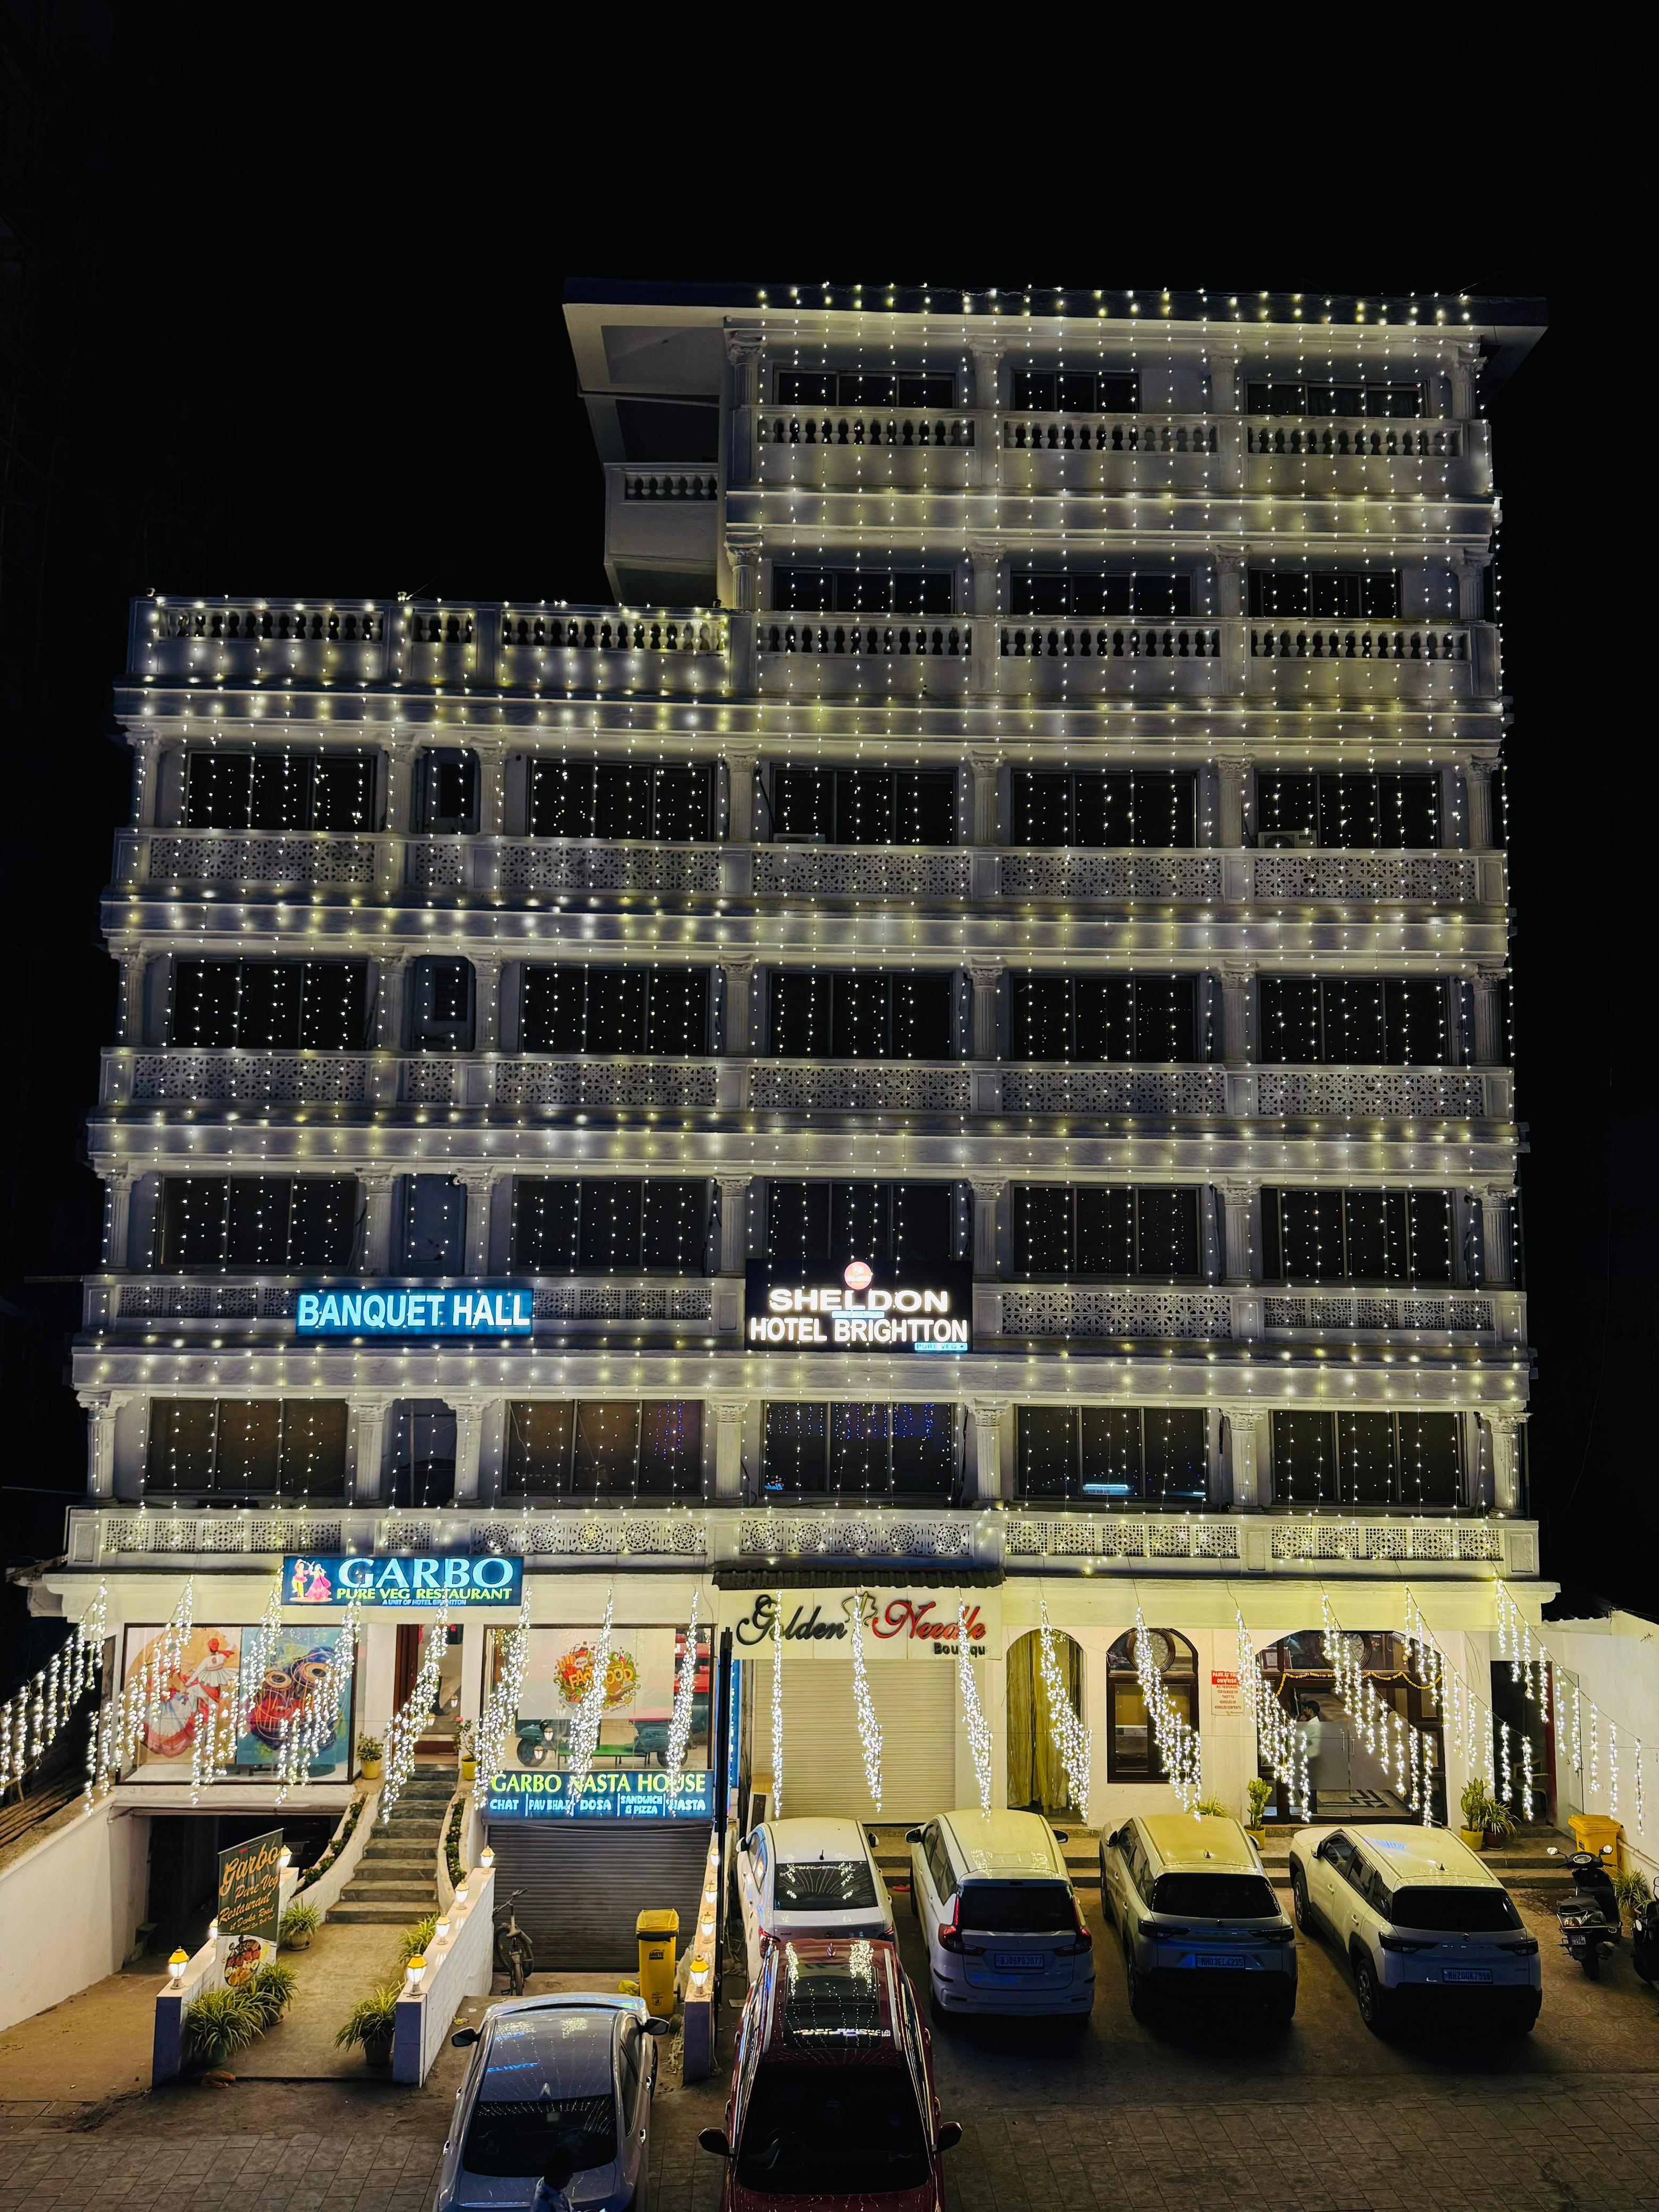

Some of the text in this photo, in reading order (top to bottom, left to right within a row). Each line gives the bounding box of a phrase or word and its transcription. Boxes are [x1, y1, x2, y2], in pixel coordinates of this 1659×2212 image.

[769, 1289, 948, 1312] SHELDON
[298, 1294, 530, 1328] BANQUET HALL
[750, 1317, 967, 1343] HOTEL BRIGHTTON
[338, 1558, 514, 1589] GARBO
[337, 1588, 513, 1600] PURE VEG RESTAURANT
[736, 1594, 986, 1646] Golden Needle
[603, 1668, 634, 1685] OOD
[491, 1773, 706, 1792] GARBO NASTA HOUSE
[490, 1799, 519, 1811] CHAT
[529, 1799, 546, 1811] PAV
[580, 1799, 611, 1811] DOSA
[621, 1795, 663, 1804] SANDWICH
[633, 1805, 658, 1814] PIZZA
[219, 1843, 280, 1897] Garbo
[234, 1874, 279, 1904] Pure Veg
[218, 1890, 272, 1925] Restaurant
[258, 1904, 275, 1919] Road
